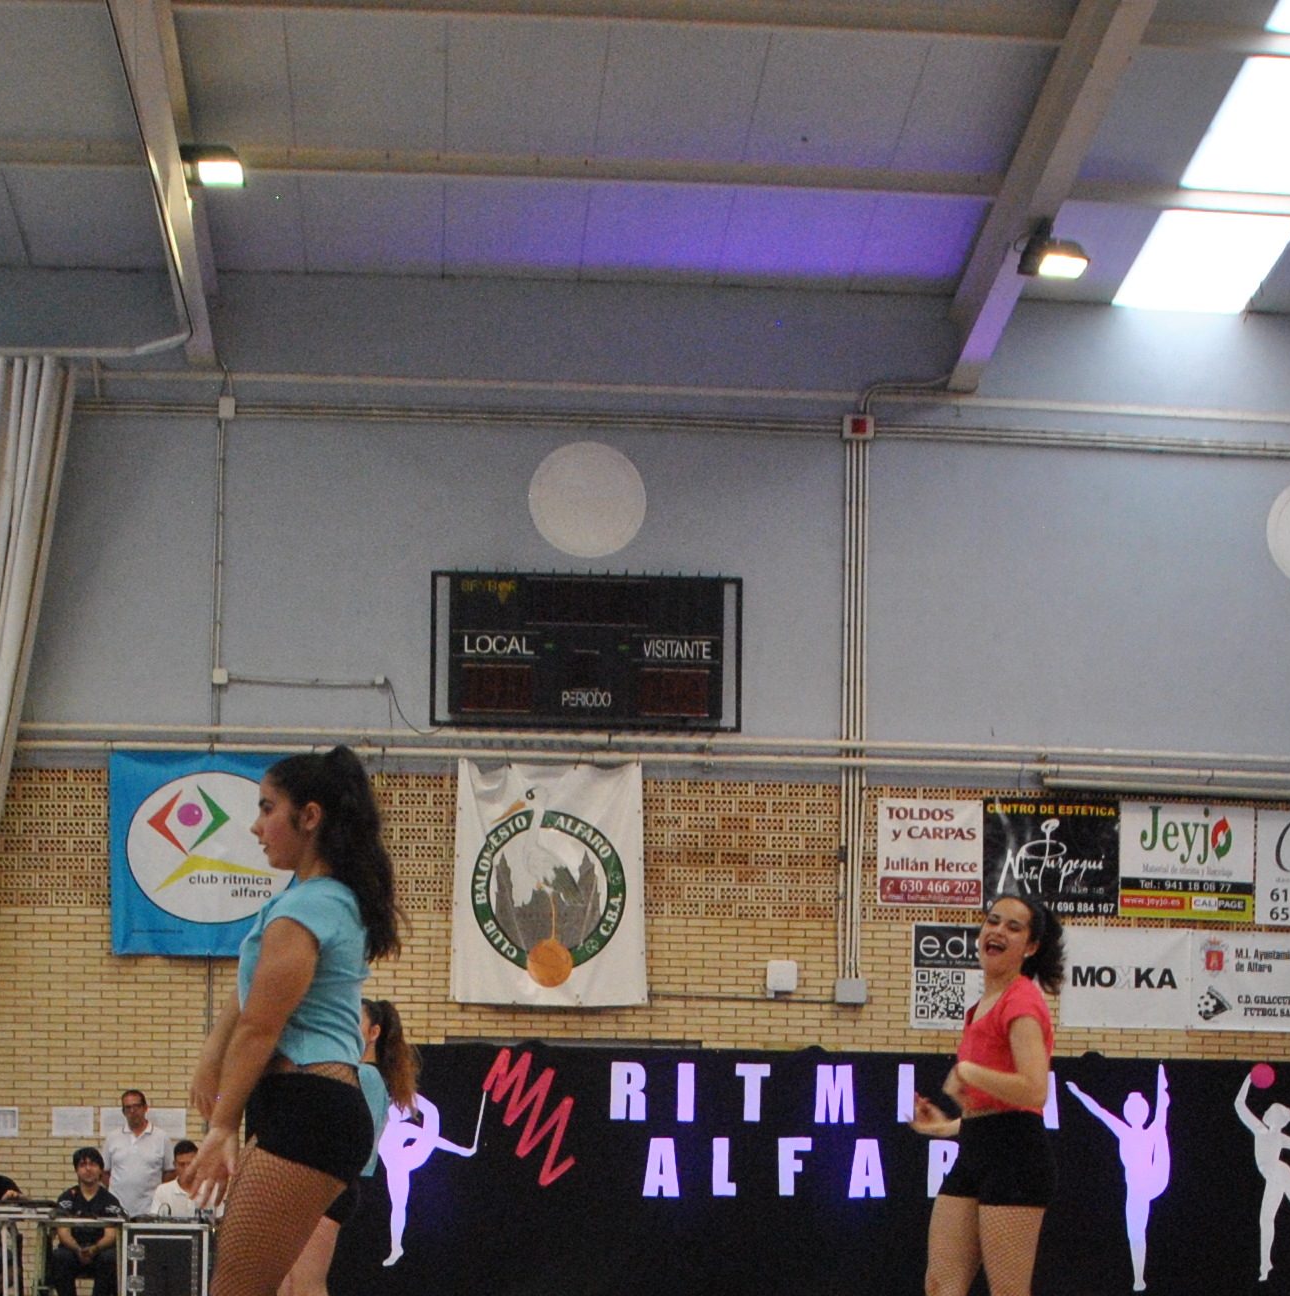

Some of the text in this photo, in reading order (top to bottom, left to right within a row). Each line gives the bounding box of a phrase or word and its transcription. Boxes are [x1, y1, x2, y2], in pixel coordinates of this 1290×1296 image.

[463, 635, 535, 655] LOCAL
[643, 640, 712, 660] VISITANTE
[561, 691, 611, 707] PERIODO
[886, 806, 955, 821] TOLDOS
[987, 803, 1116, 816] CENTRO DE ESTETICA
[891, 826, 977, 841] y CARPAS
[884, 856, 978, 872] Julián Herce
[189, 874, 218, 885] club
[899, 880, 977, 894] 630 466 202
[1164, 880, 1183, 891] 941
[1188, 881, 1200, 891] 18
[1219, 883, 1232, 893] 77
[230, 887, 272, 899] alfaro
[484, 919, 518, 960] CLUB
[555, 815, 612, 859] ALFARO
[1057, 901, 1075, 912] 696
[1077, 902, 1095, 912] 884
[1098, 903, 1115, 913] 167
[1235, 962, 1272, 973] de Alfaro
[642, 1136, 960, 1199] ALFAR
